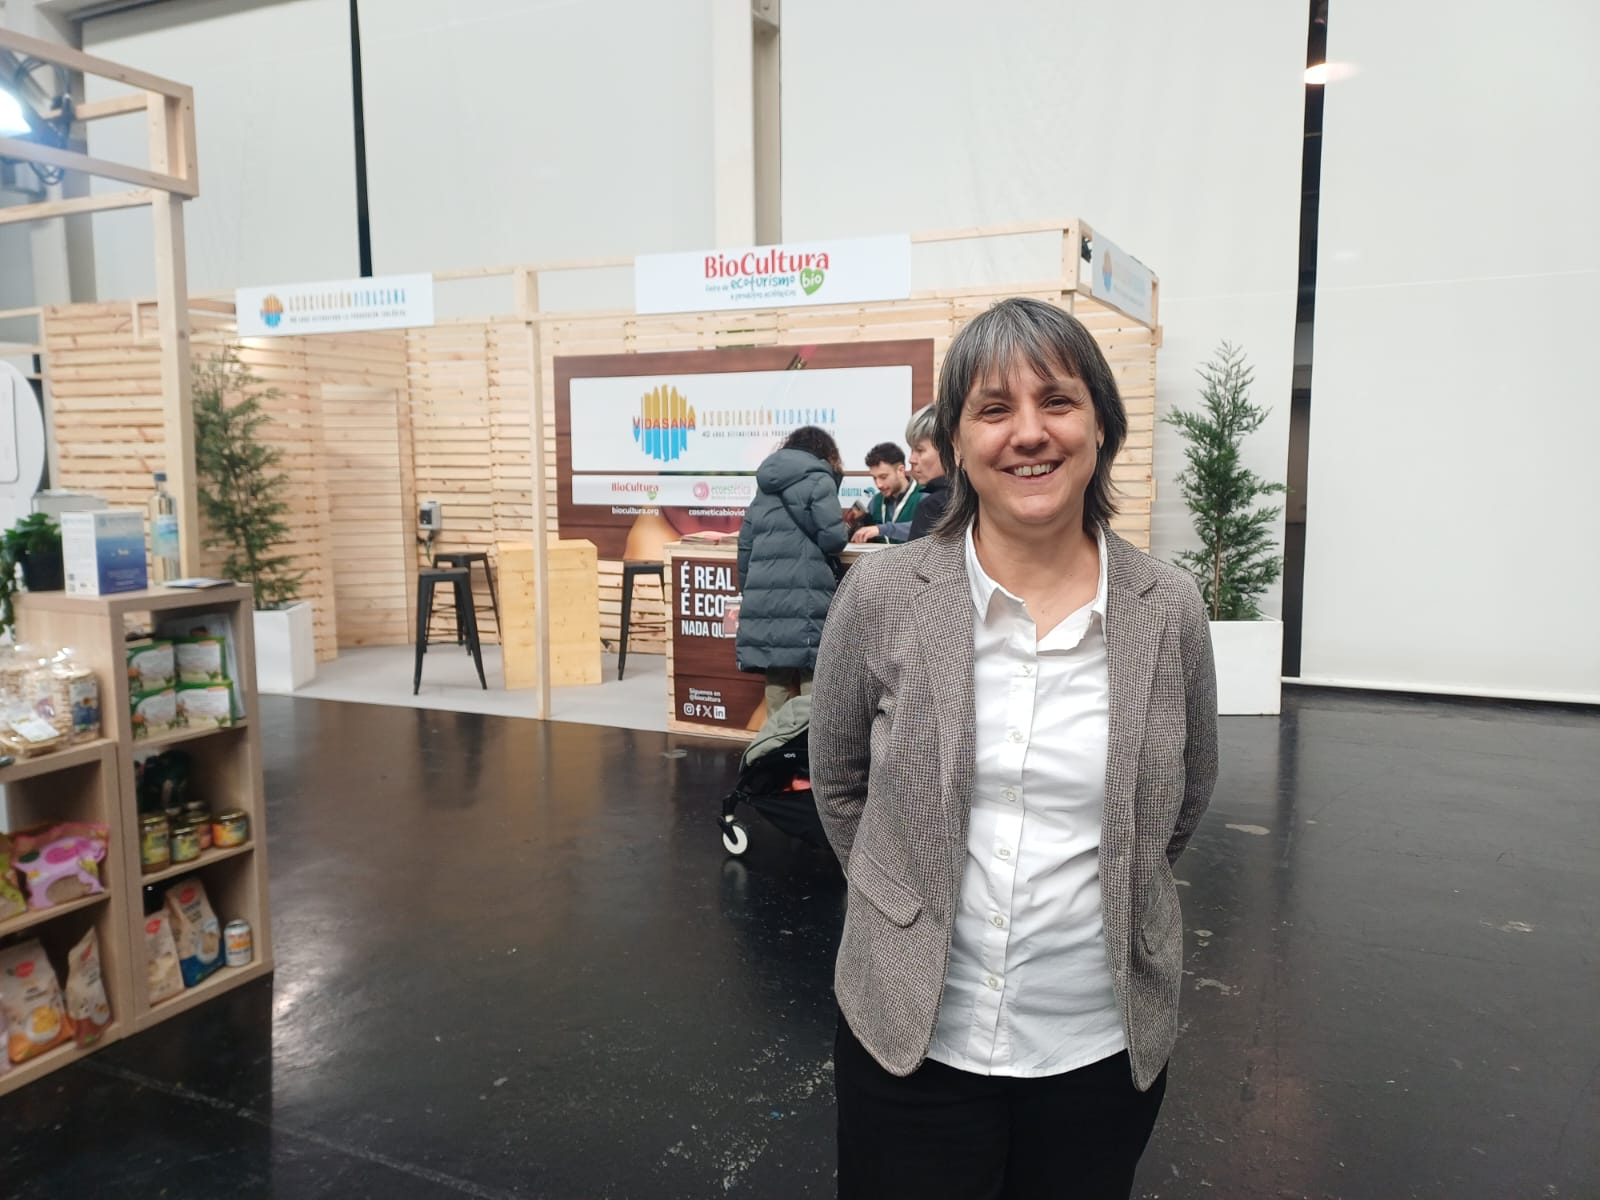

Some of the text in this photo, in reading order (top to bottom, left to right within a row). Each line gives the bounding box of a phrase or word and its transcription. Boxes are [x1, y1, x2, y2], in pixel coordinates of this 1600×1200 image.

[705, 249, 830, 279] BioCultura
[731, 274, 796, 292] ecoturismo
[801, 272, 821, 288] bio
[611, 481, 659, 493] BioCultura
[611, 507, 660, 517] biocultura.org
[680, 561, 737, 591] É REAL
[680, 588, 691, 615] É
[681, 619, 710, 637] NADA
